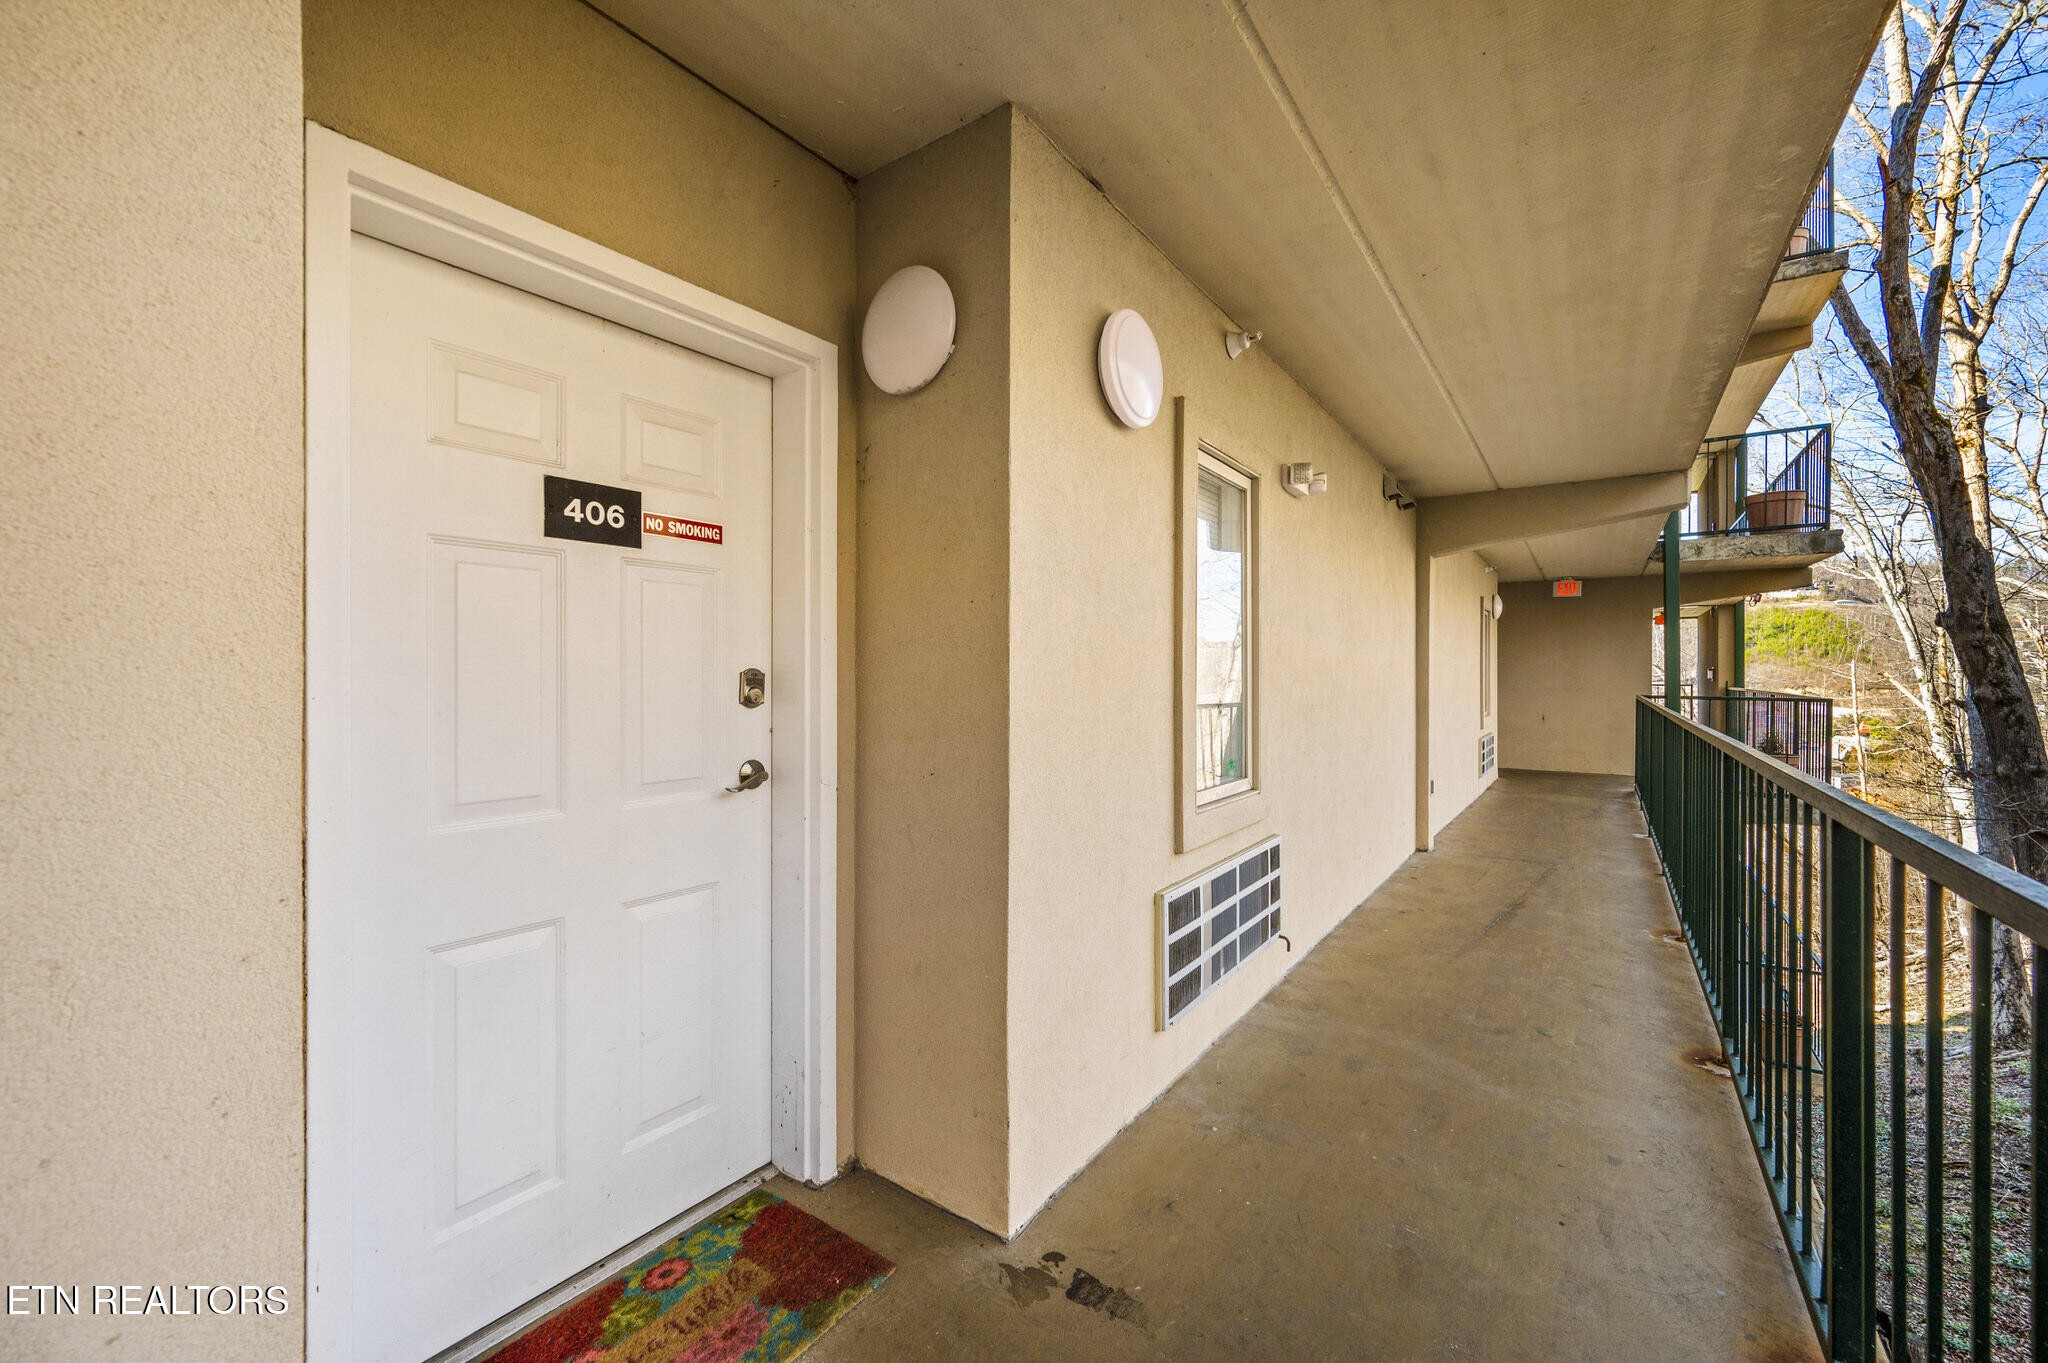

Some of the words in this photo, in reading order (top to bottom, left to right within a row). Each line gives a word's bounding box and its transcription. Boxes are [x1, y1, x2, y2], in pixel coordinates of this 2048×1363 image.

[564, 498, 625, 528] 406
[646, 517, 663, 531] NO
[668, 521, 720, 540] SMOKING
[1557, 581, 1578, 596] EXIT
